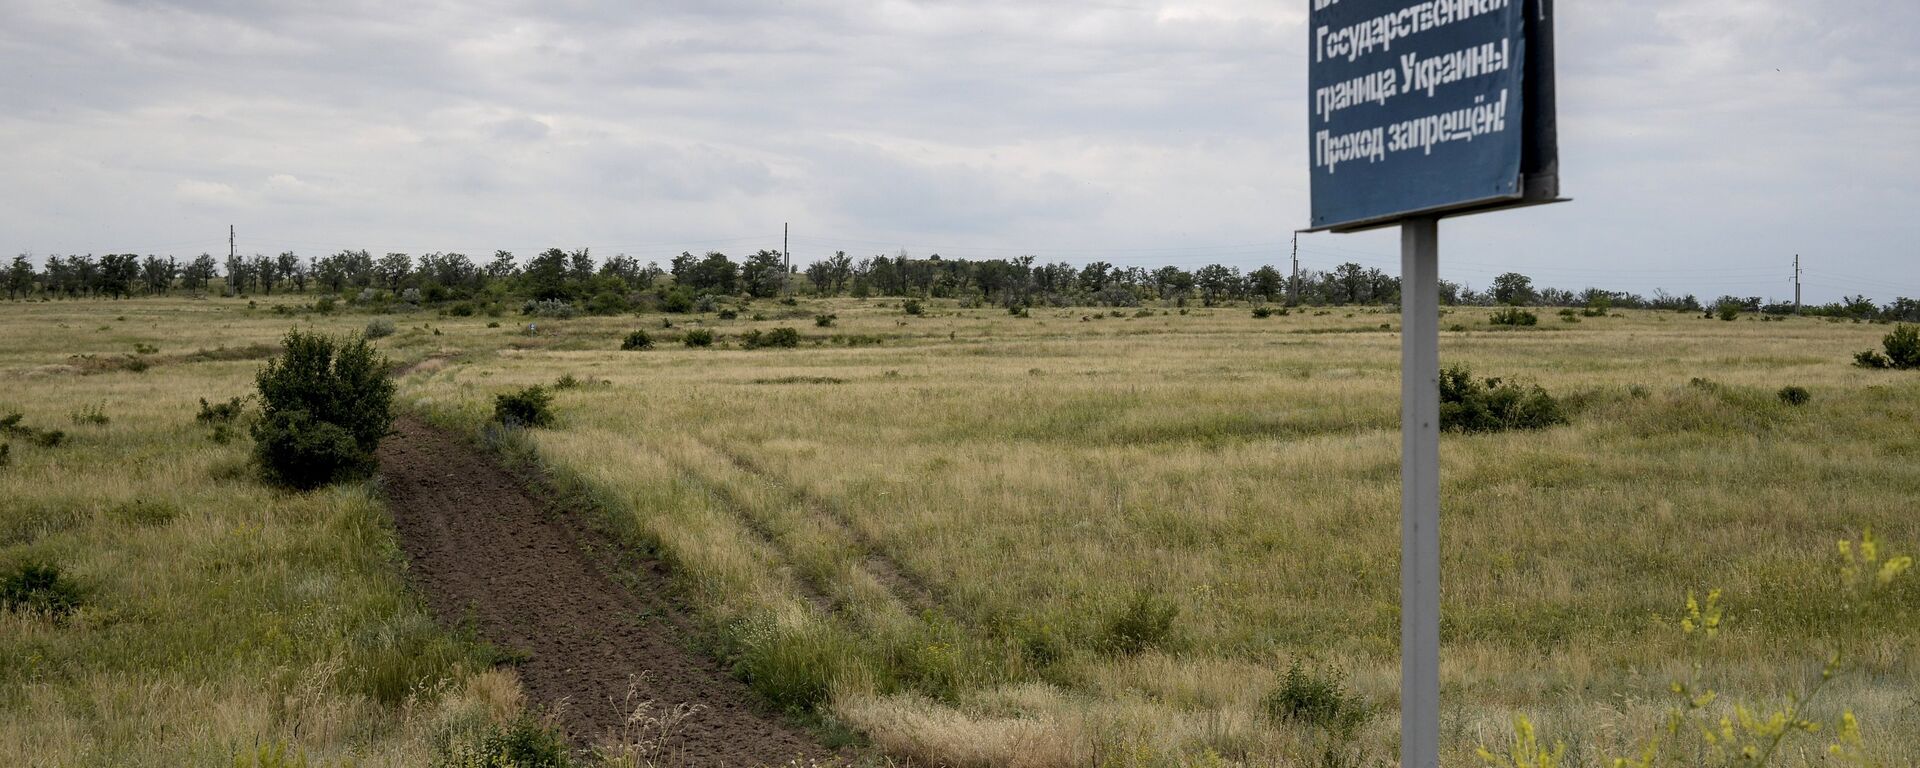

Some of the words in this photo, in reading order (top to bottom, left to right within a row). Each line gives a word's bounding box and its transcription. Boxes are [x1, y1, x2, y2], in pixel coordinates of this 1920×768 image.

[1316, 0, 1508, 62] Государственн
[1316, 68, 1397, 123] граница
[1400, 38, 1509, 98] Украины
[1316, 126, 1385, 174] Проход
[1388, 88, 1508, 156] запрещён!
